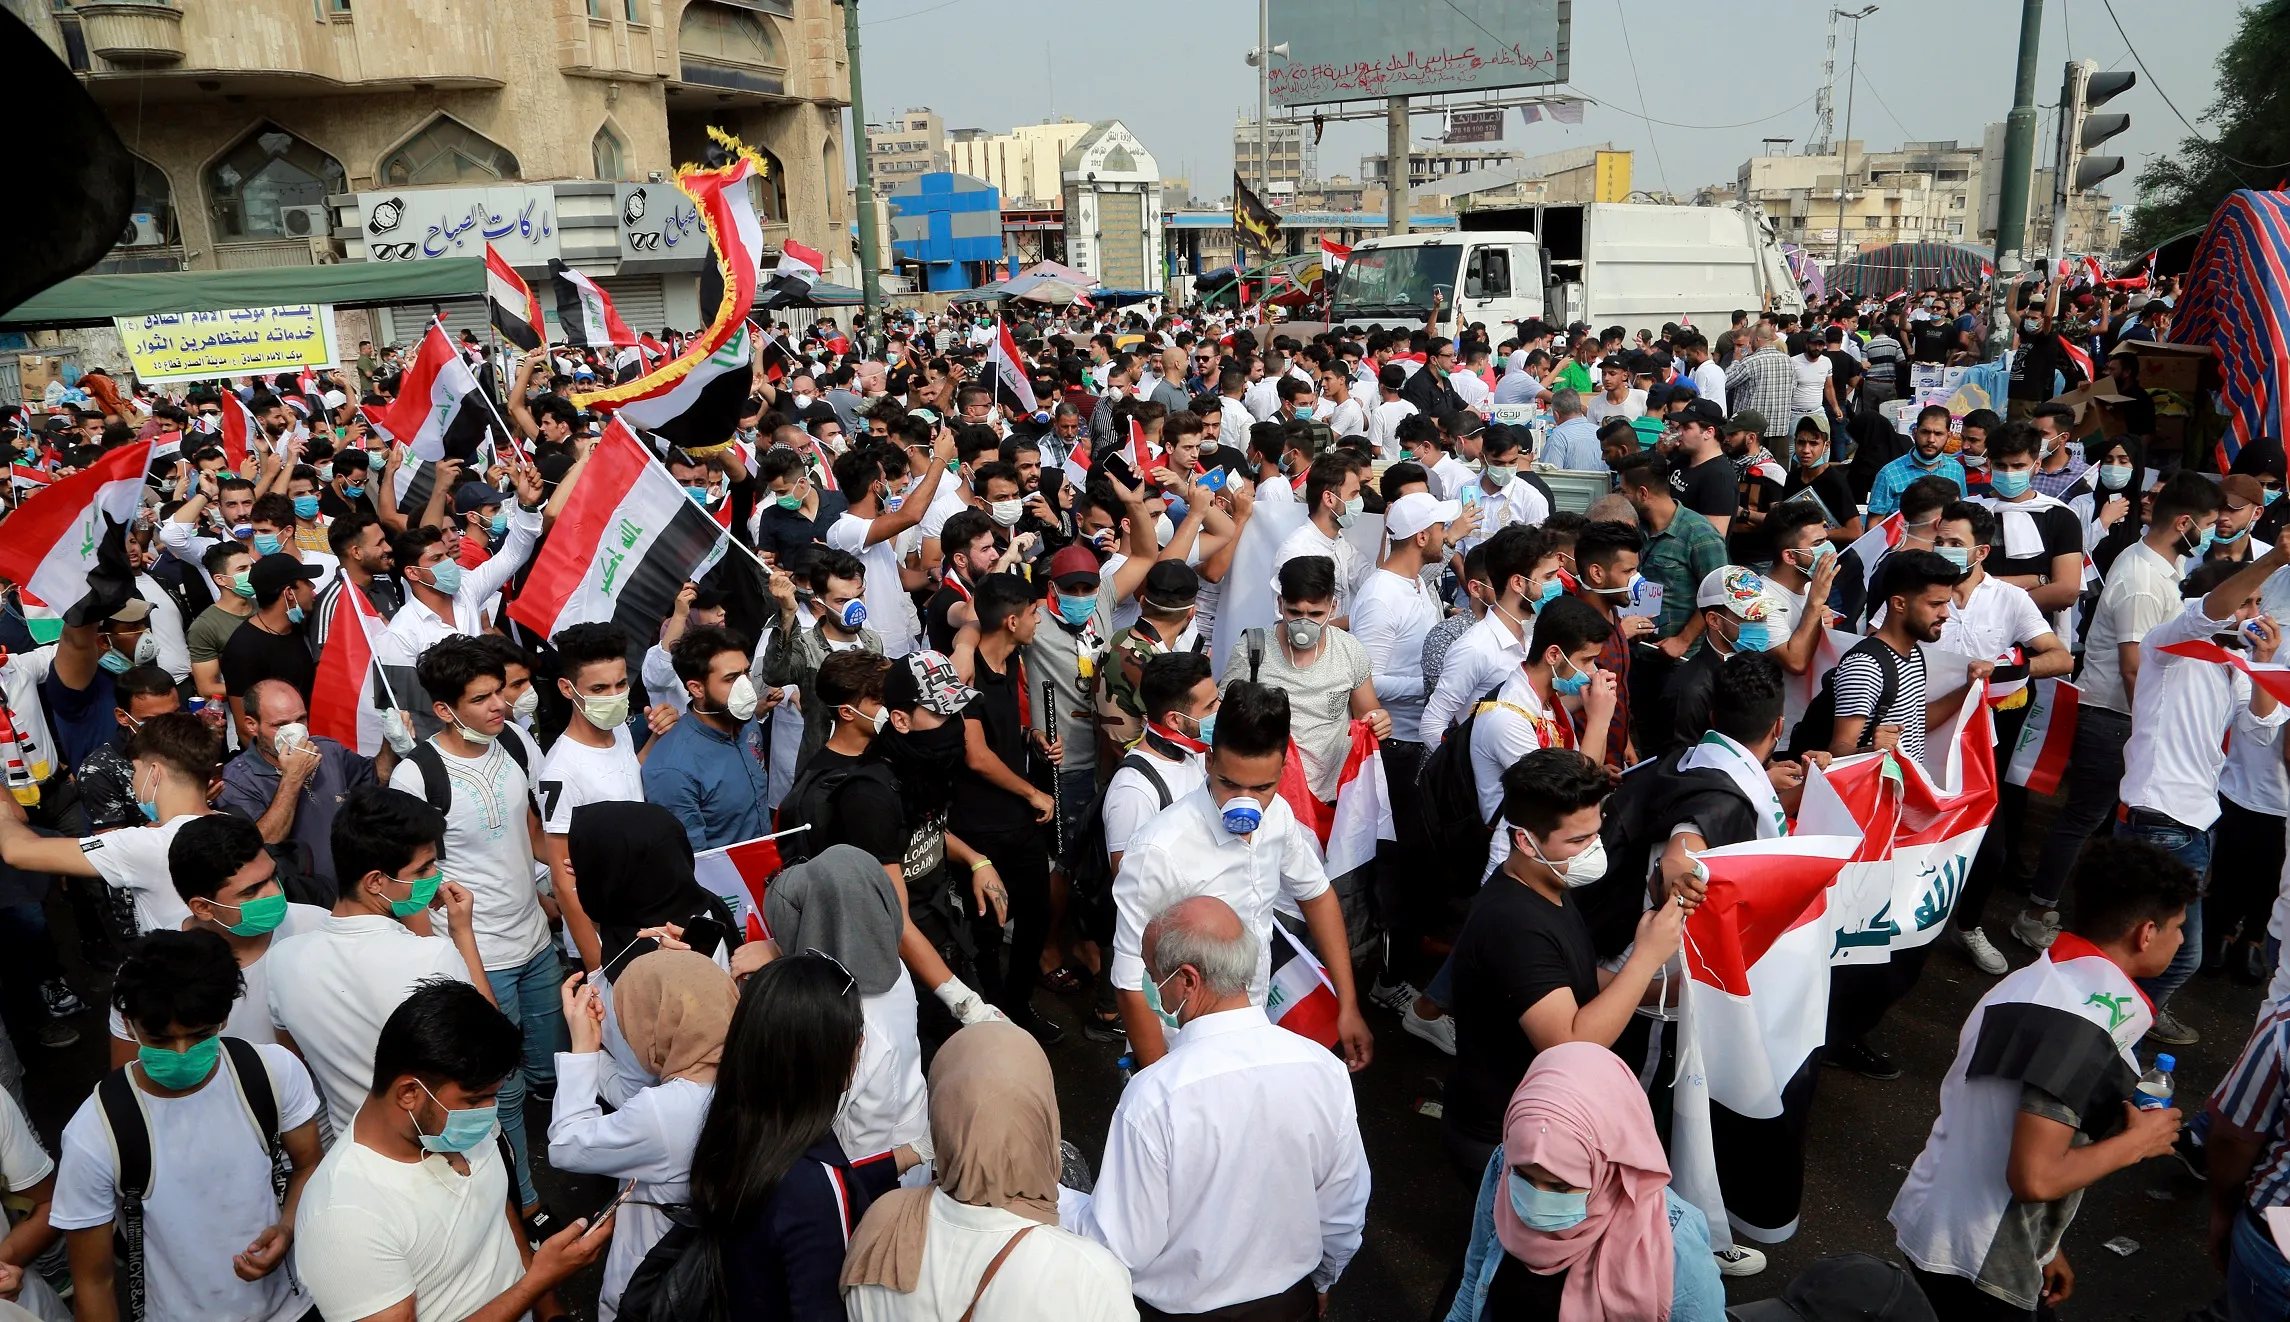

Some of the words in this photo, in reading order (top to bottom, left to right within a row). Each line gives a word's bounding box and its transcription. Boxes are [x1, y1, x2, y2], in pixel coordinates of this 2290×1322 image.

[134, 333, 174, 356] الثوار
[180, 330, 260, 352] للمتظاهرين
[266, 325, 315, 343] خدماته
[184, 357, 205, 371] الصدر
[207, 355, 227, 369] مدينة
[539, 781, 563, 823] 7
[904, 831, 940, 864] LOADING
[902, 853, 934, 878] AGAIN
